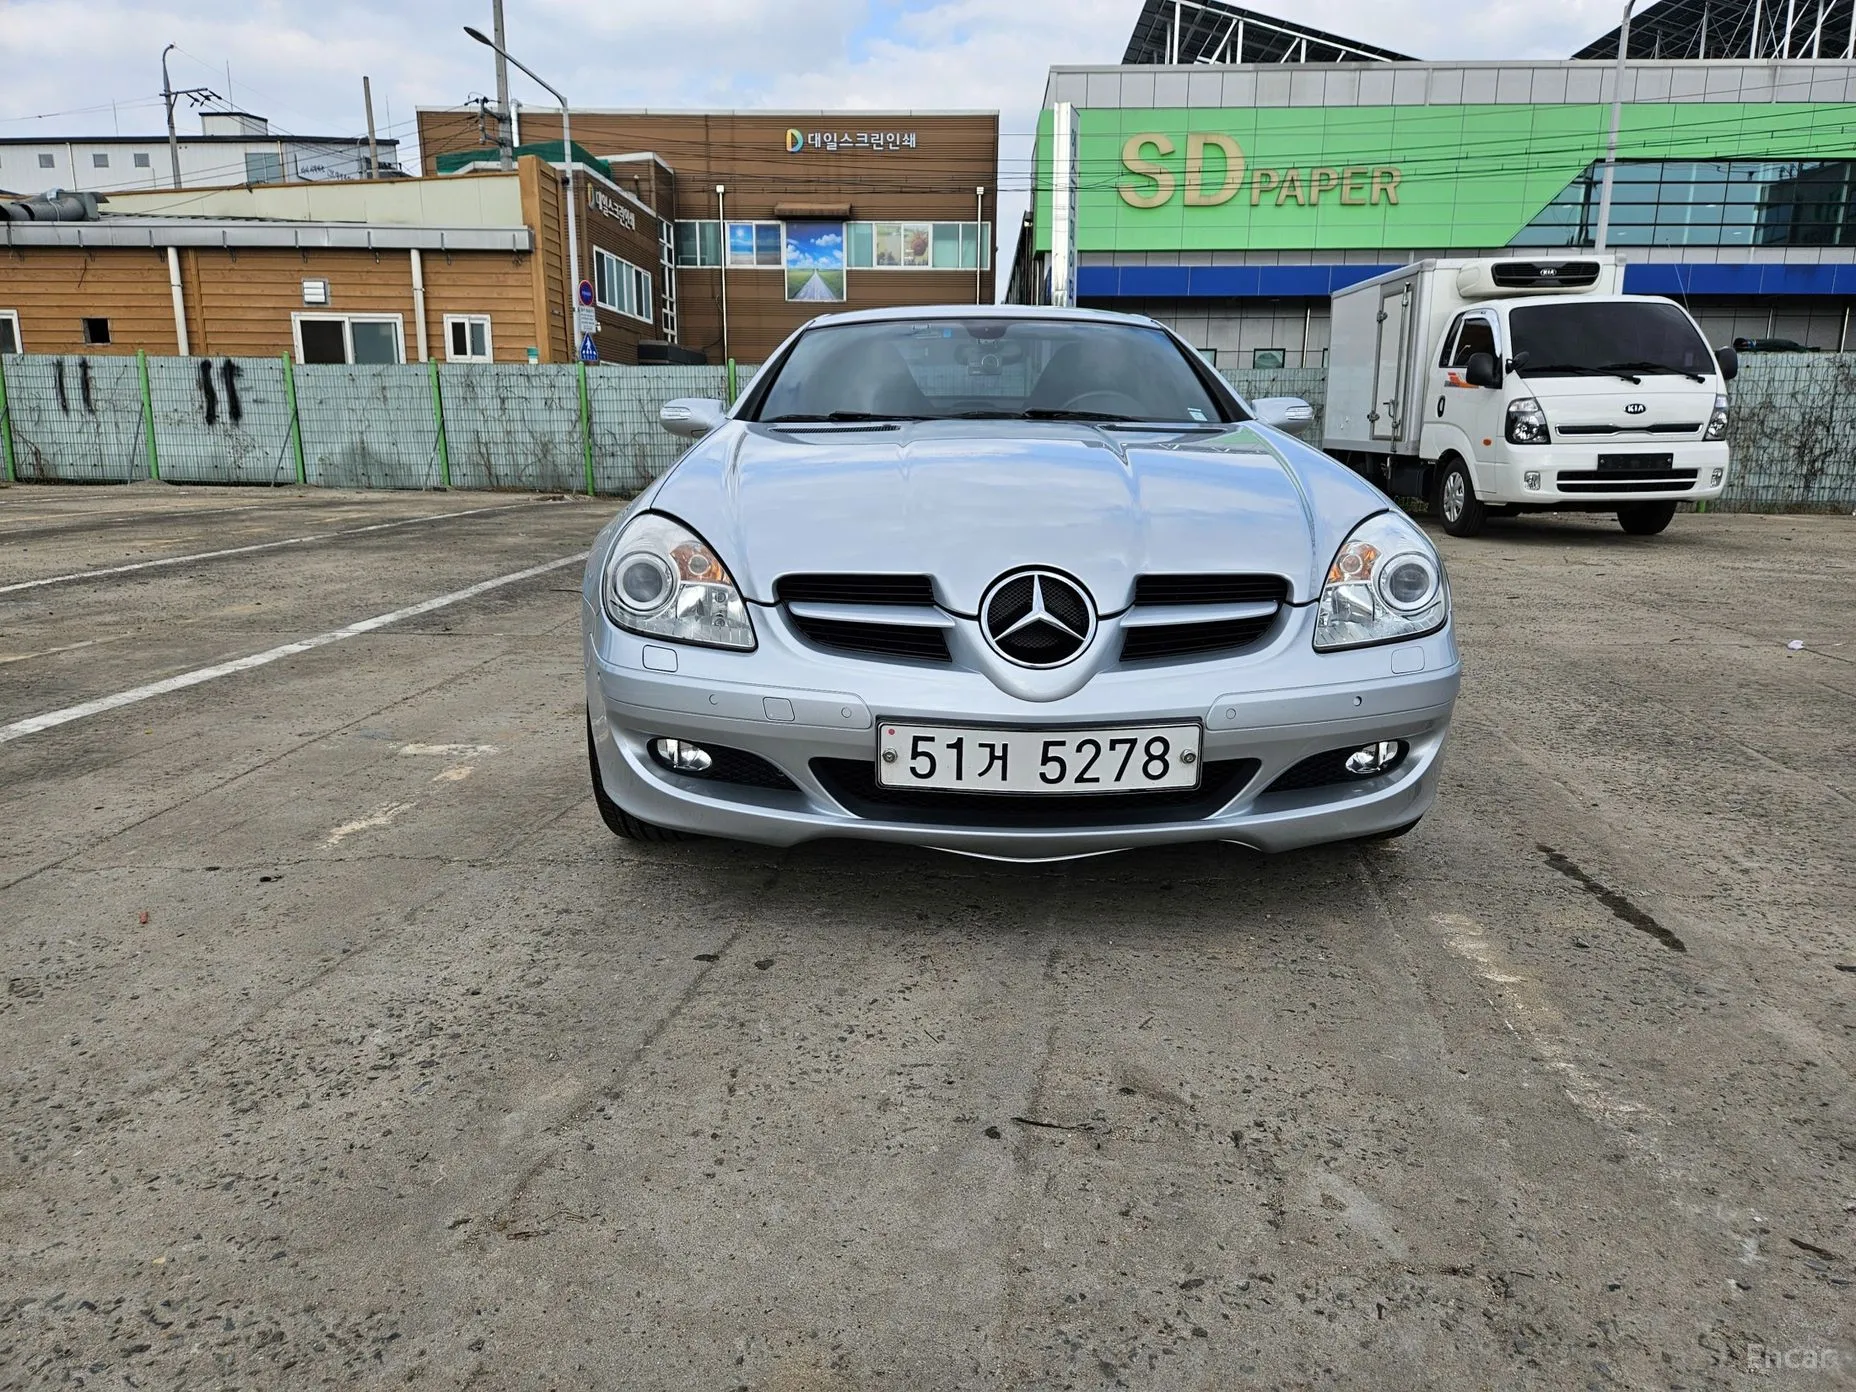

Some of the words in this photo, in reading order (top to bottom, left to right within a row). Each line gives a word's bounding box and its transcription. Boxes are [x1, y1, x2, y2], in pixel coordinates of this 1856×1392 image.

[807, 132, 917, 151] 대일스크린인쇄
[1118, 131, 1246, 209] SD
[1250, 166, 1401, 207] PAPER
[1627, 404, 1645, 413] KIA
[909, 735, 1009, 781] 51거
[1038, 735, 1171, 784] 5278
